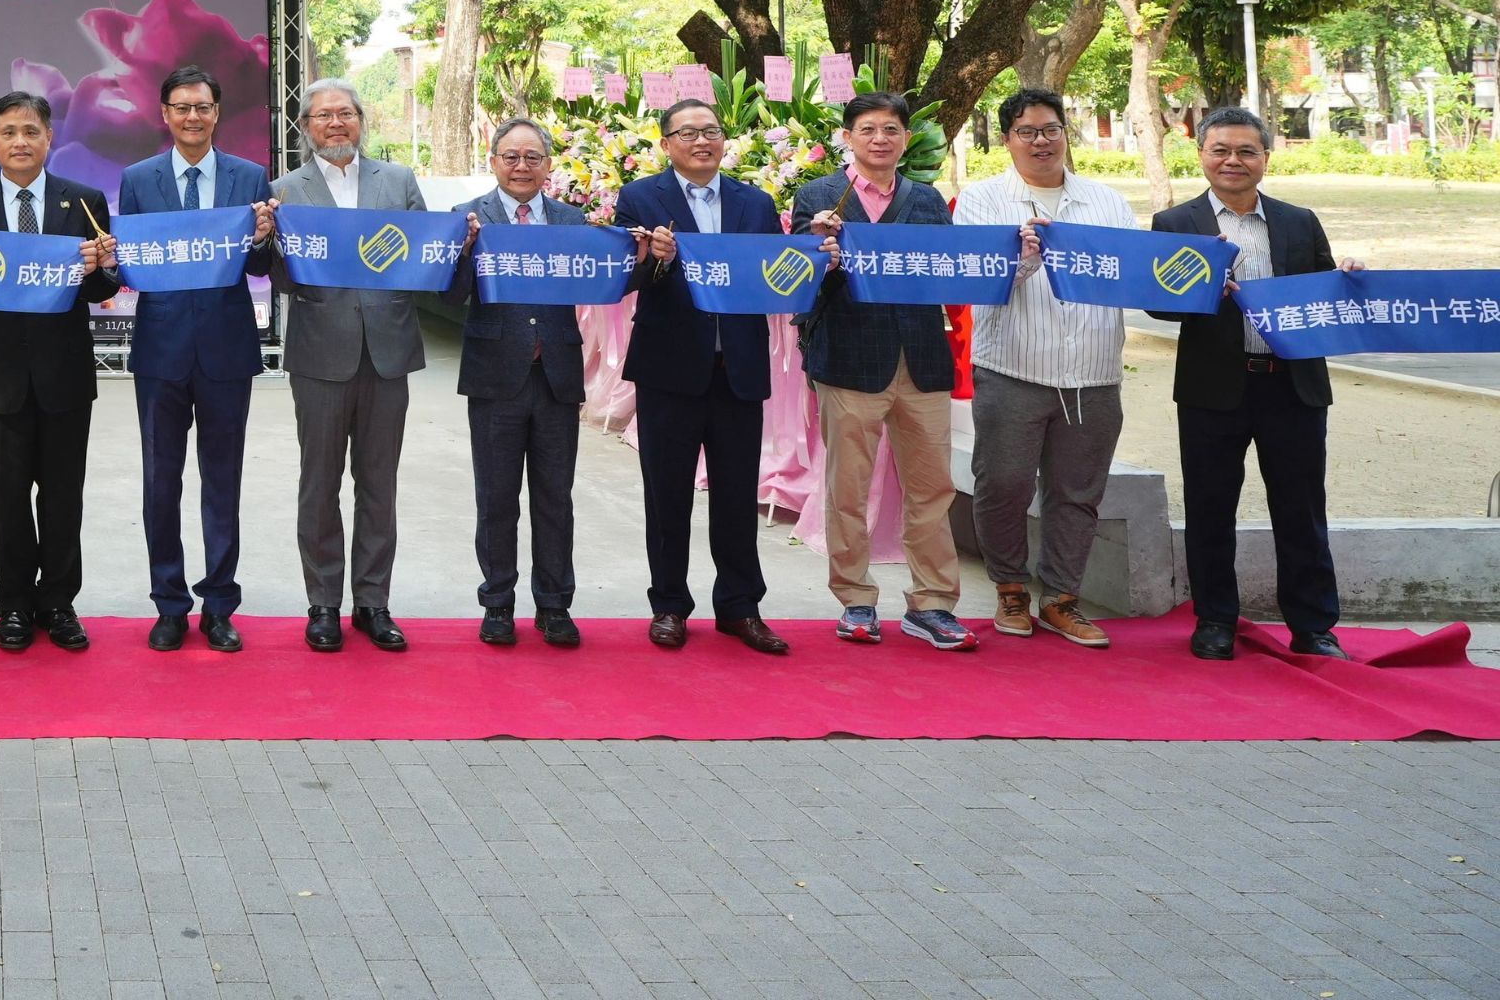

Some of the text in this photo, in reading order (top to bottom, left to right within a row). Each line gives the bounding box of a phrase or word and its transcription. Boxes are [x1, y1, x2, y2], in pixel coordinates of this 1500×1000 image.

[282, 232, 329, 260] 浪潮
[16, 261, 86, 288] 成材產
[681, 260, 731, 288] 浪潮
[1041, 247, 1121, 281] 年浪潮
[1245, 297, 1500, 334] 材產業論壇的十年浪
